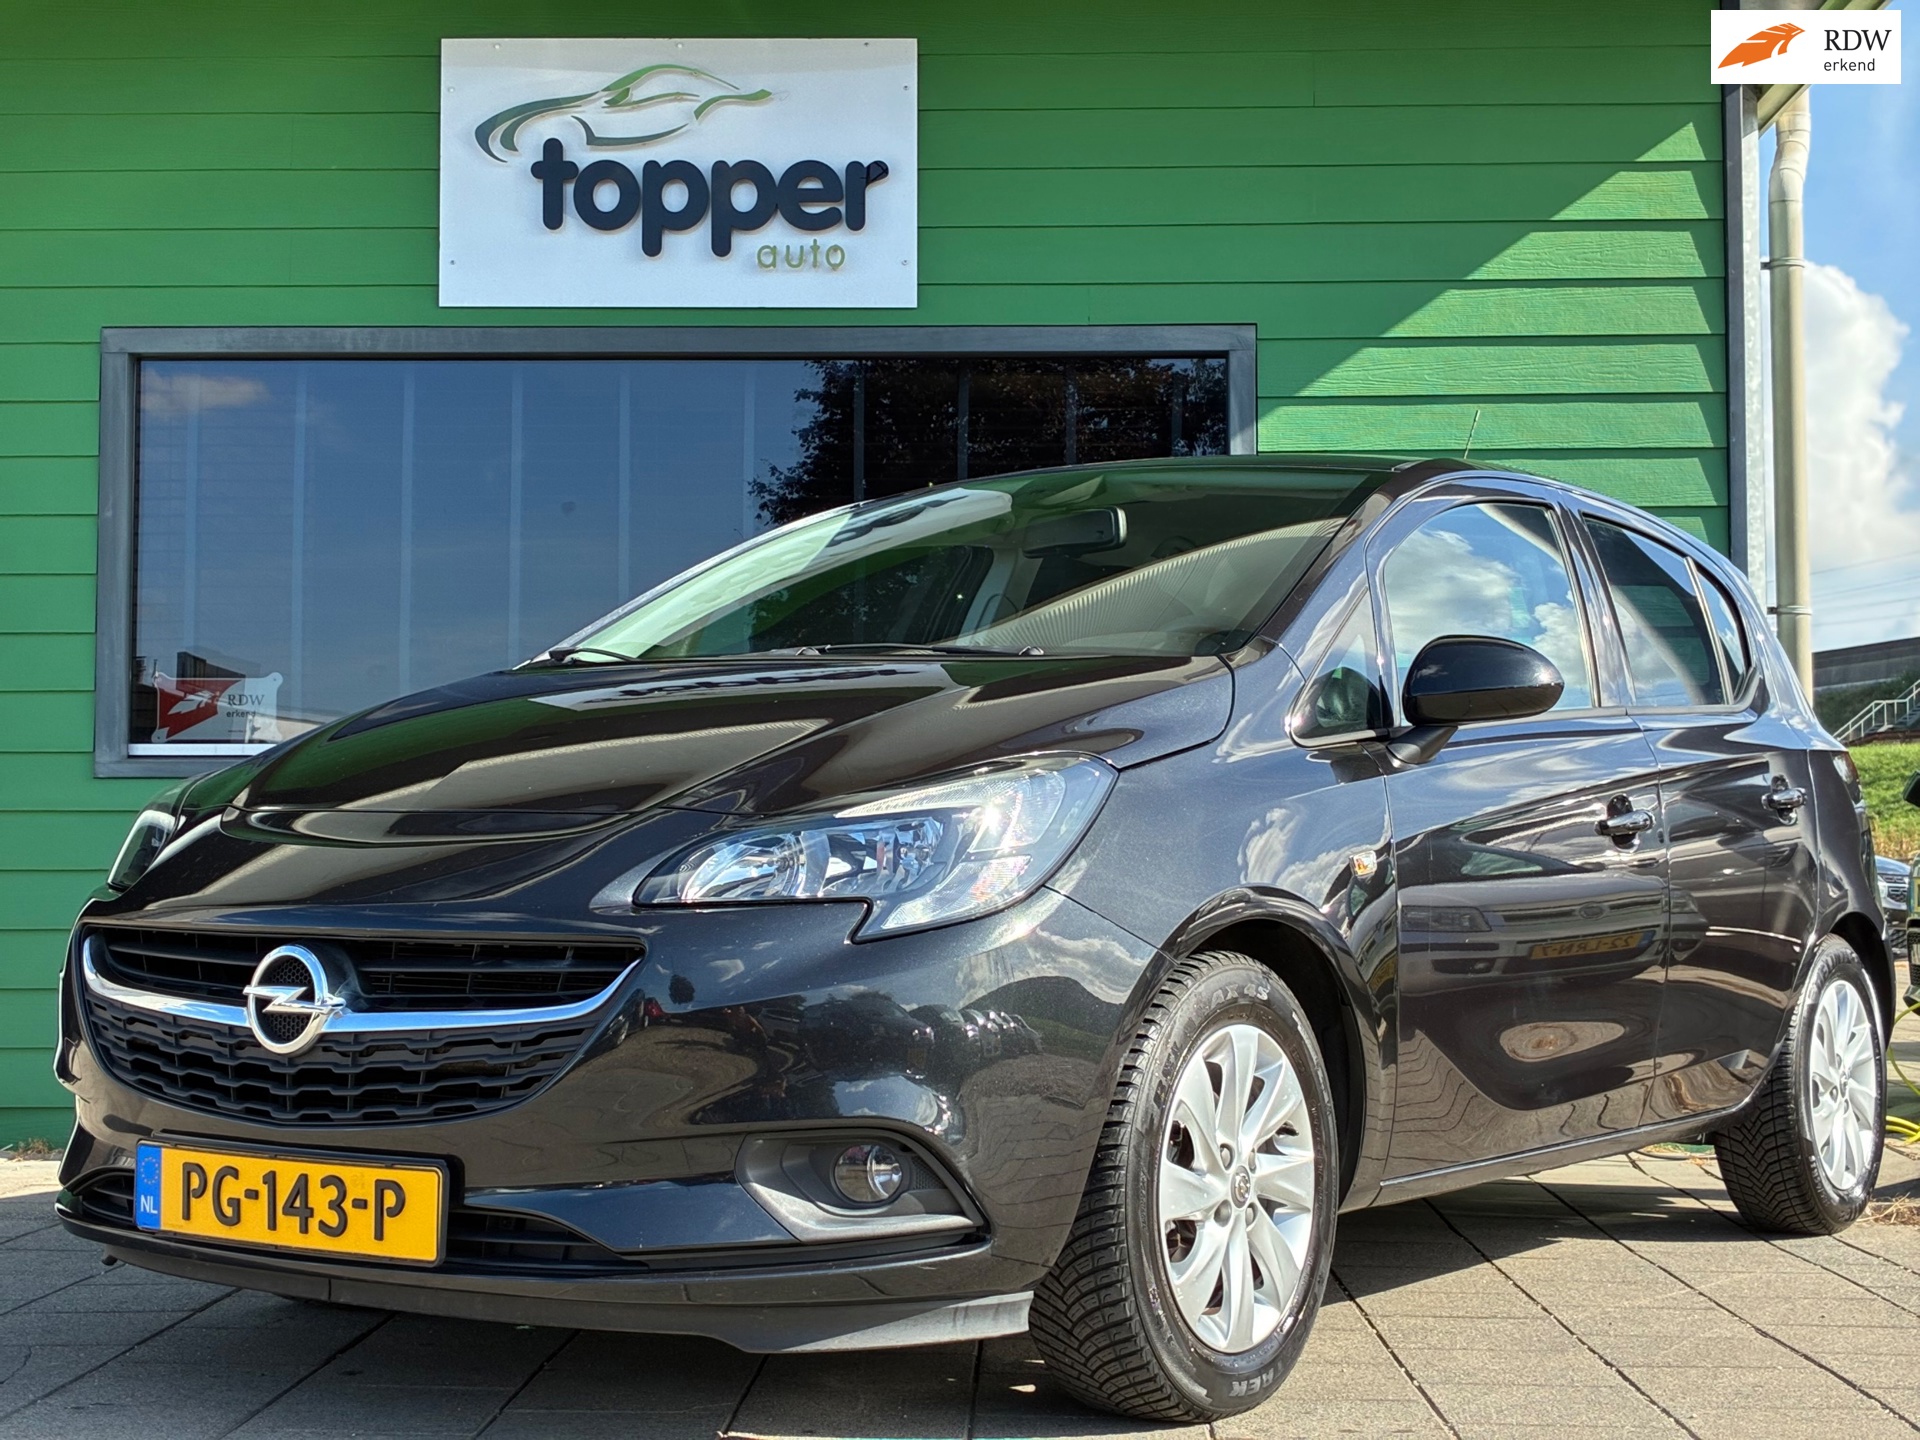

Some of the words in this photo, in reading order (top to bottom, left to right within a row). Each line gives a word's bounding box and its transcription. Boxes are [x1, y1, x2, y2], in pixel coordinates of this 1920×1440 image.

[531, 138, 889, 257] topper
[757, 238, 846, 270] auto
[227, 694, 265, 706] RDW
[140, 1194, 158, 1214] NL
[181, 1161, 406, 1241] PG-143-P
